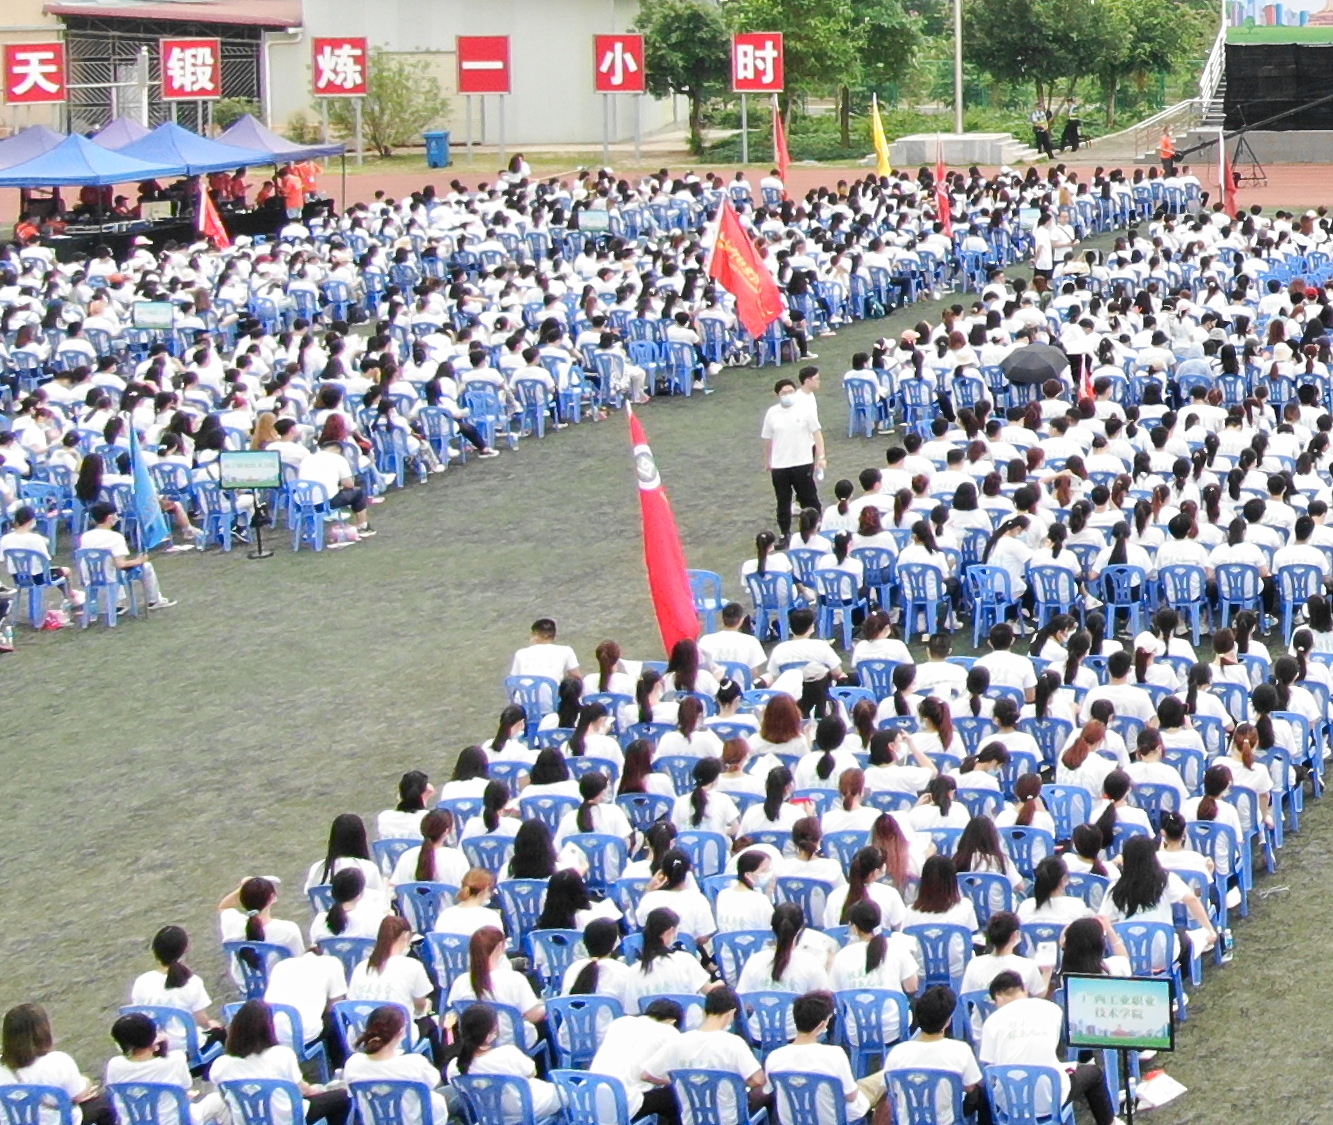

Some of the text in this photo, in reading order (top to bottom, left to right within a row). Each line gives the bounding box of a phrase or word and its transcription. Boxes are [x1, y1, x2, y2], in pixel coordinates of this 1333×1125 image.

[11, 40, 778, 94] 天 锻 炼 一 小 时
